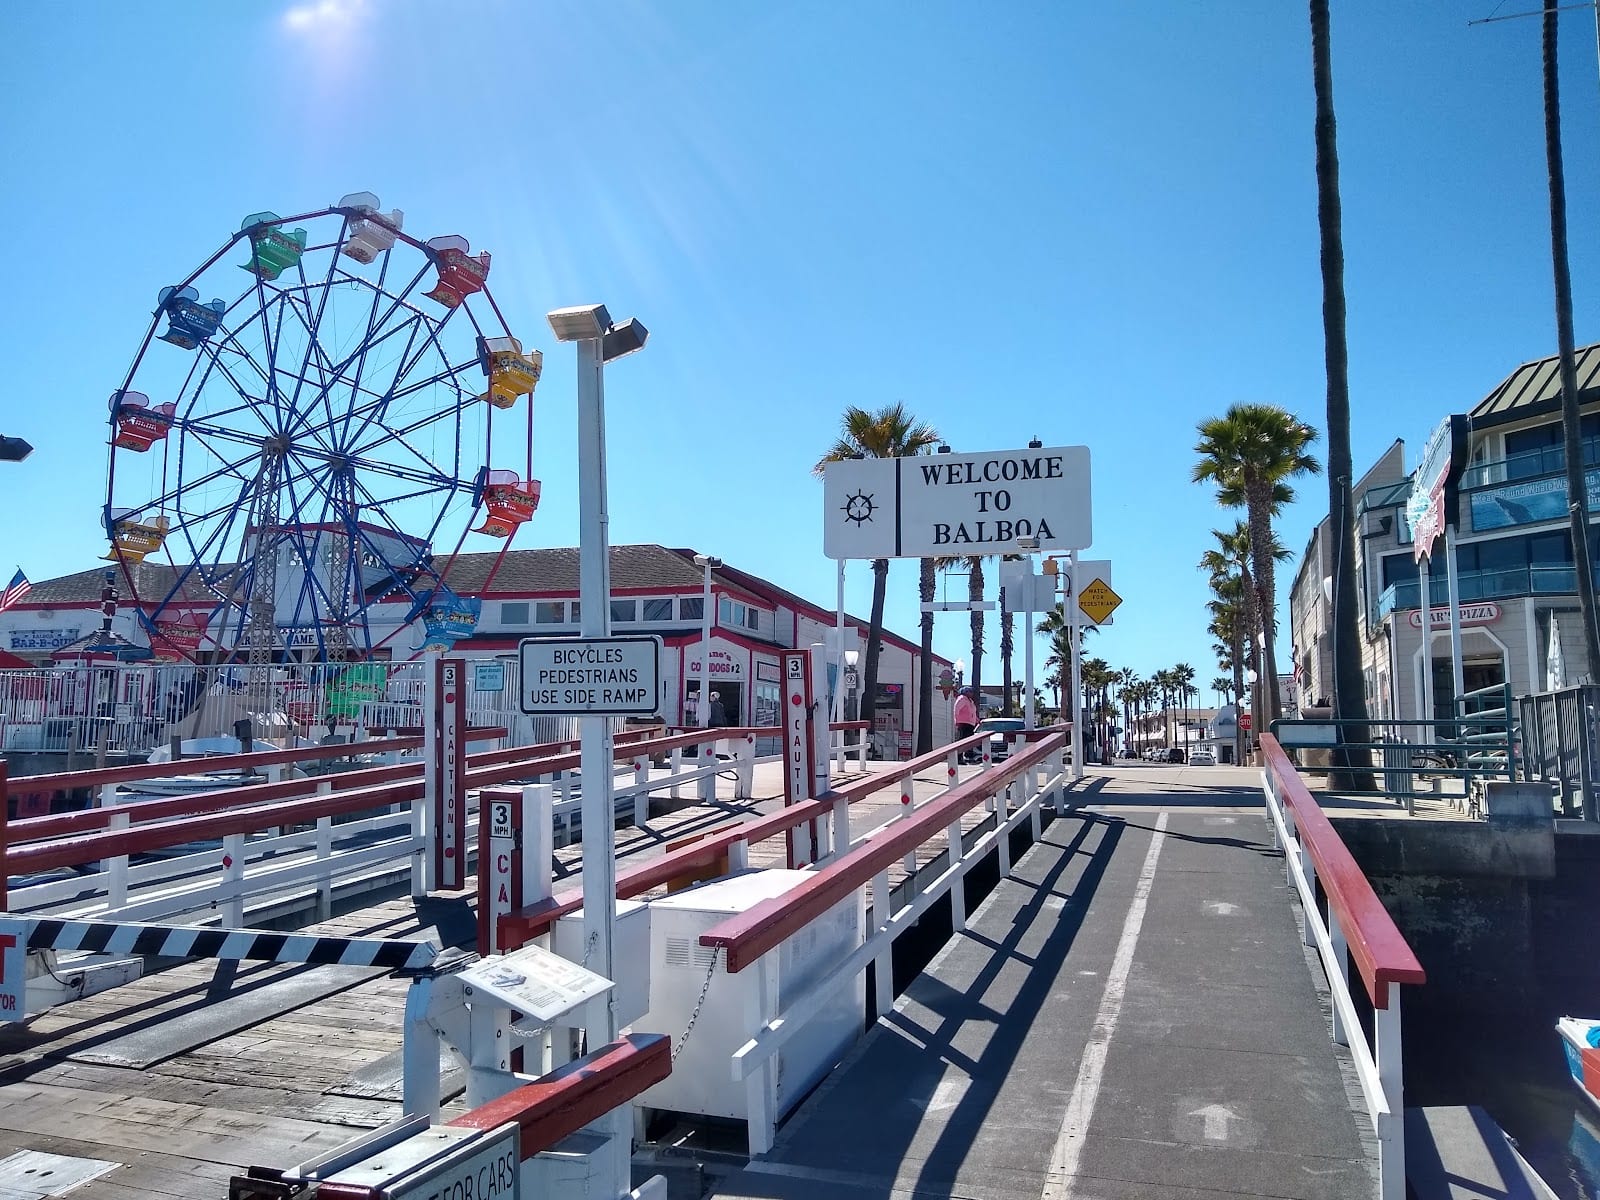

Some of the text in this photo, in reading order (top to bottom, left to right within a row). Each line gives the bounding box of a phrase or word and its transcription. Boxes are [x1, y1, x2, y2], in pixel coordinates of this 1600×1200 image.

[920, 456, 1063, 486] WELCOME
[1527, 483, 1553, 495] Whale
[974, 490, 1011, 512] TO
[933, 518, 1055, 545] BALBOA
[1415, 607, 1494, 624] AAR' PIZZA
[292, 634, 314, 645] AME
[553, 648, 623, 664] BICYCLES
[445, 669, 453, 679] 3
[691, 661, 731, 673] CODOGS
[791, 660, 799, 672] 3
[539, 668, 638, 684] PEDESTRIANS
[531, 688, 647, 704] USE SIDE RAMP
[495, 805, 508, 825] 3
[494, 826, 509, 835] MPH
[497, 854, 509, 903] CA
[477, 1151, 514, 1200] CARS
